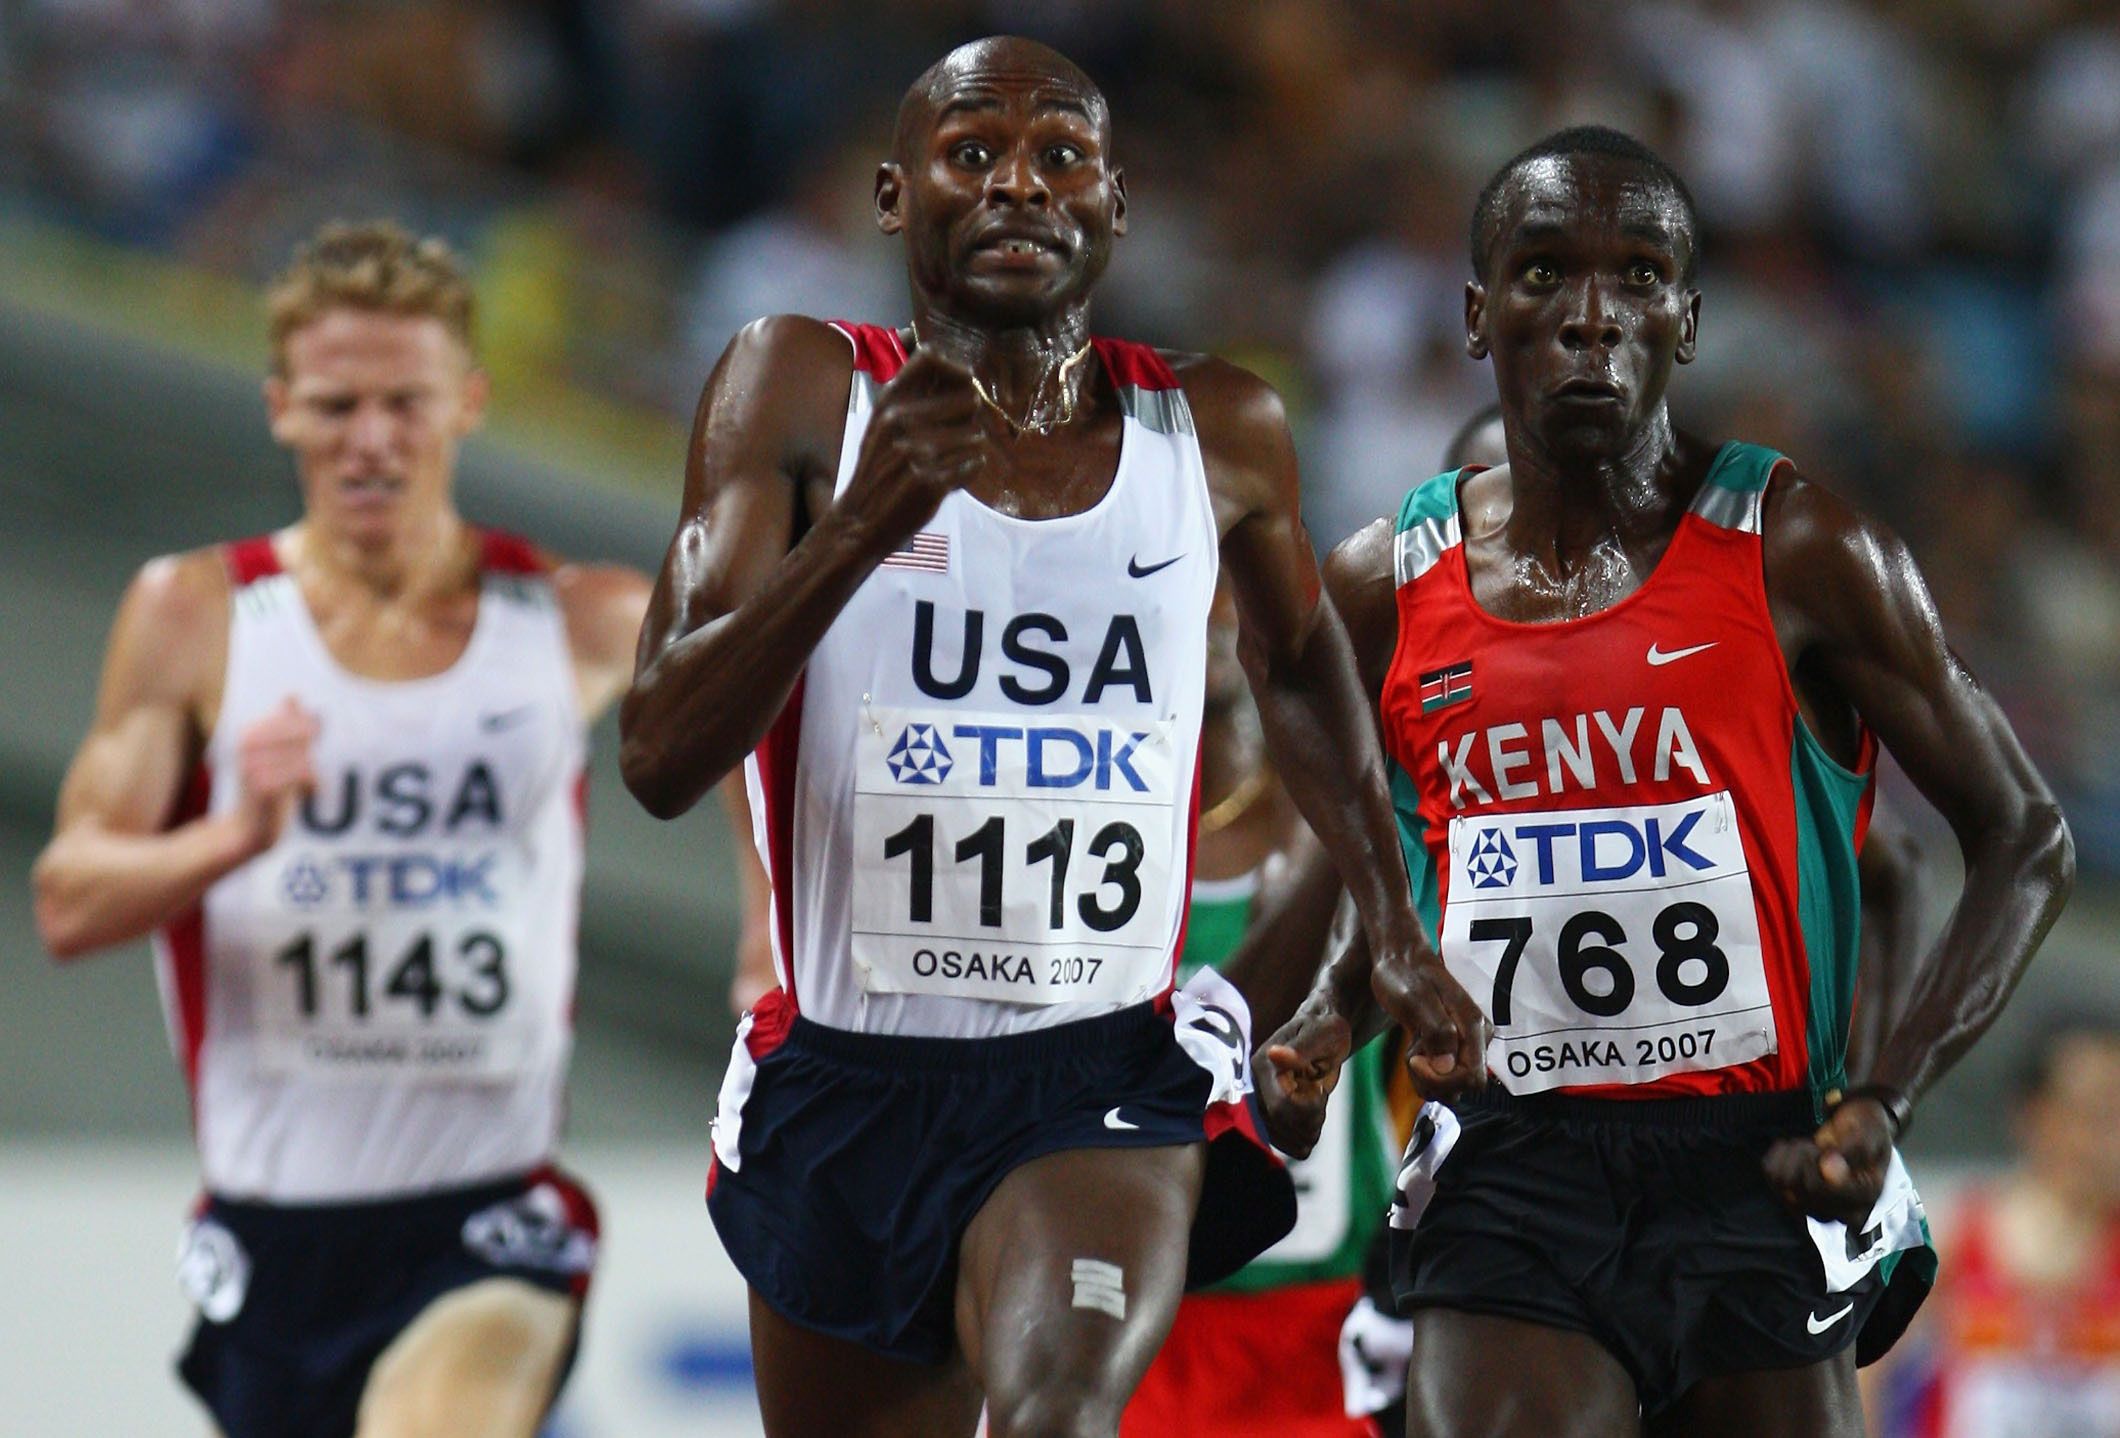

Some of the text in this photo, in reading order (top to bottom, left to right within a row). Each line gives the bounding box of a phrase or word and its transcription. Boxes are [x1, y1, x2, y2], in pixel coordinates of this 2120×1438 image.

[912, 600, 1152, 705] USA
[953, 724, 1151, 793] TDK
[1437, 707, 1711, 810] KENYA
[302, 761, 501, 837] USA
[342, 857, 498, 905] TDK
[884, 814, 1145, 932] 1113
[1515, 809, 1717, 885] TDK
[277, 929, 510, 1018] 1143
[912, 949, 1104, 985] OSAKA 2007
[1469, 902, 1729, 1026] 768
[1507, 1029, 1717, 1078] OSAKA 2007
